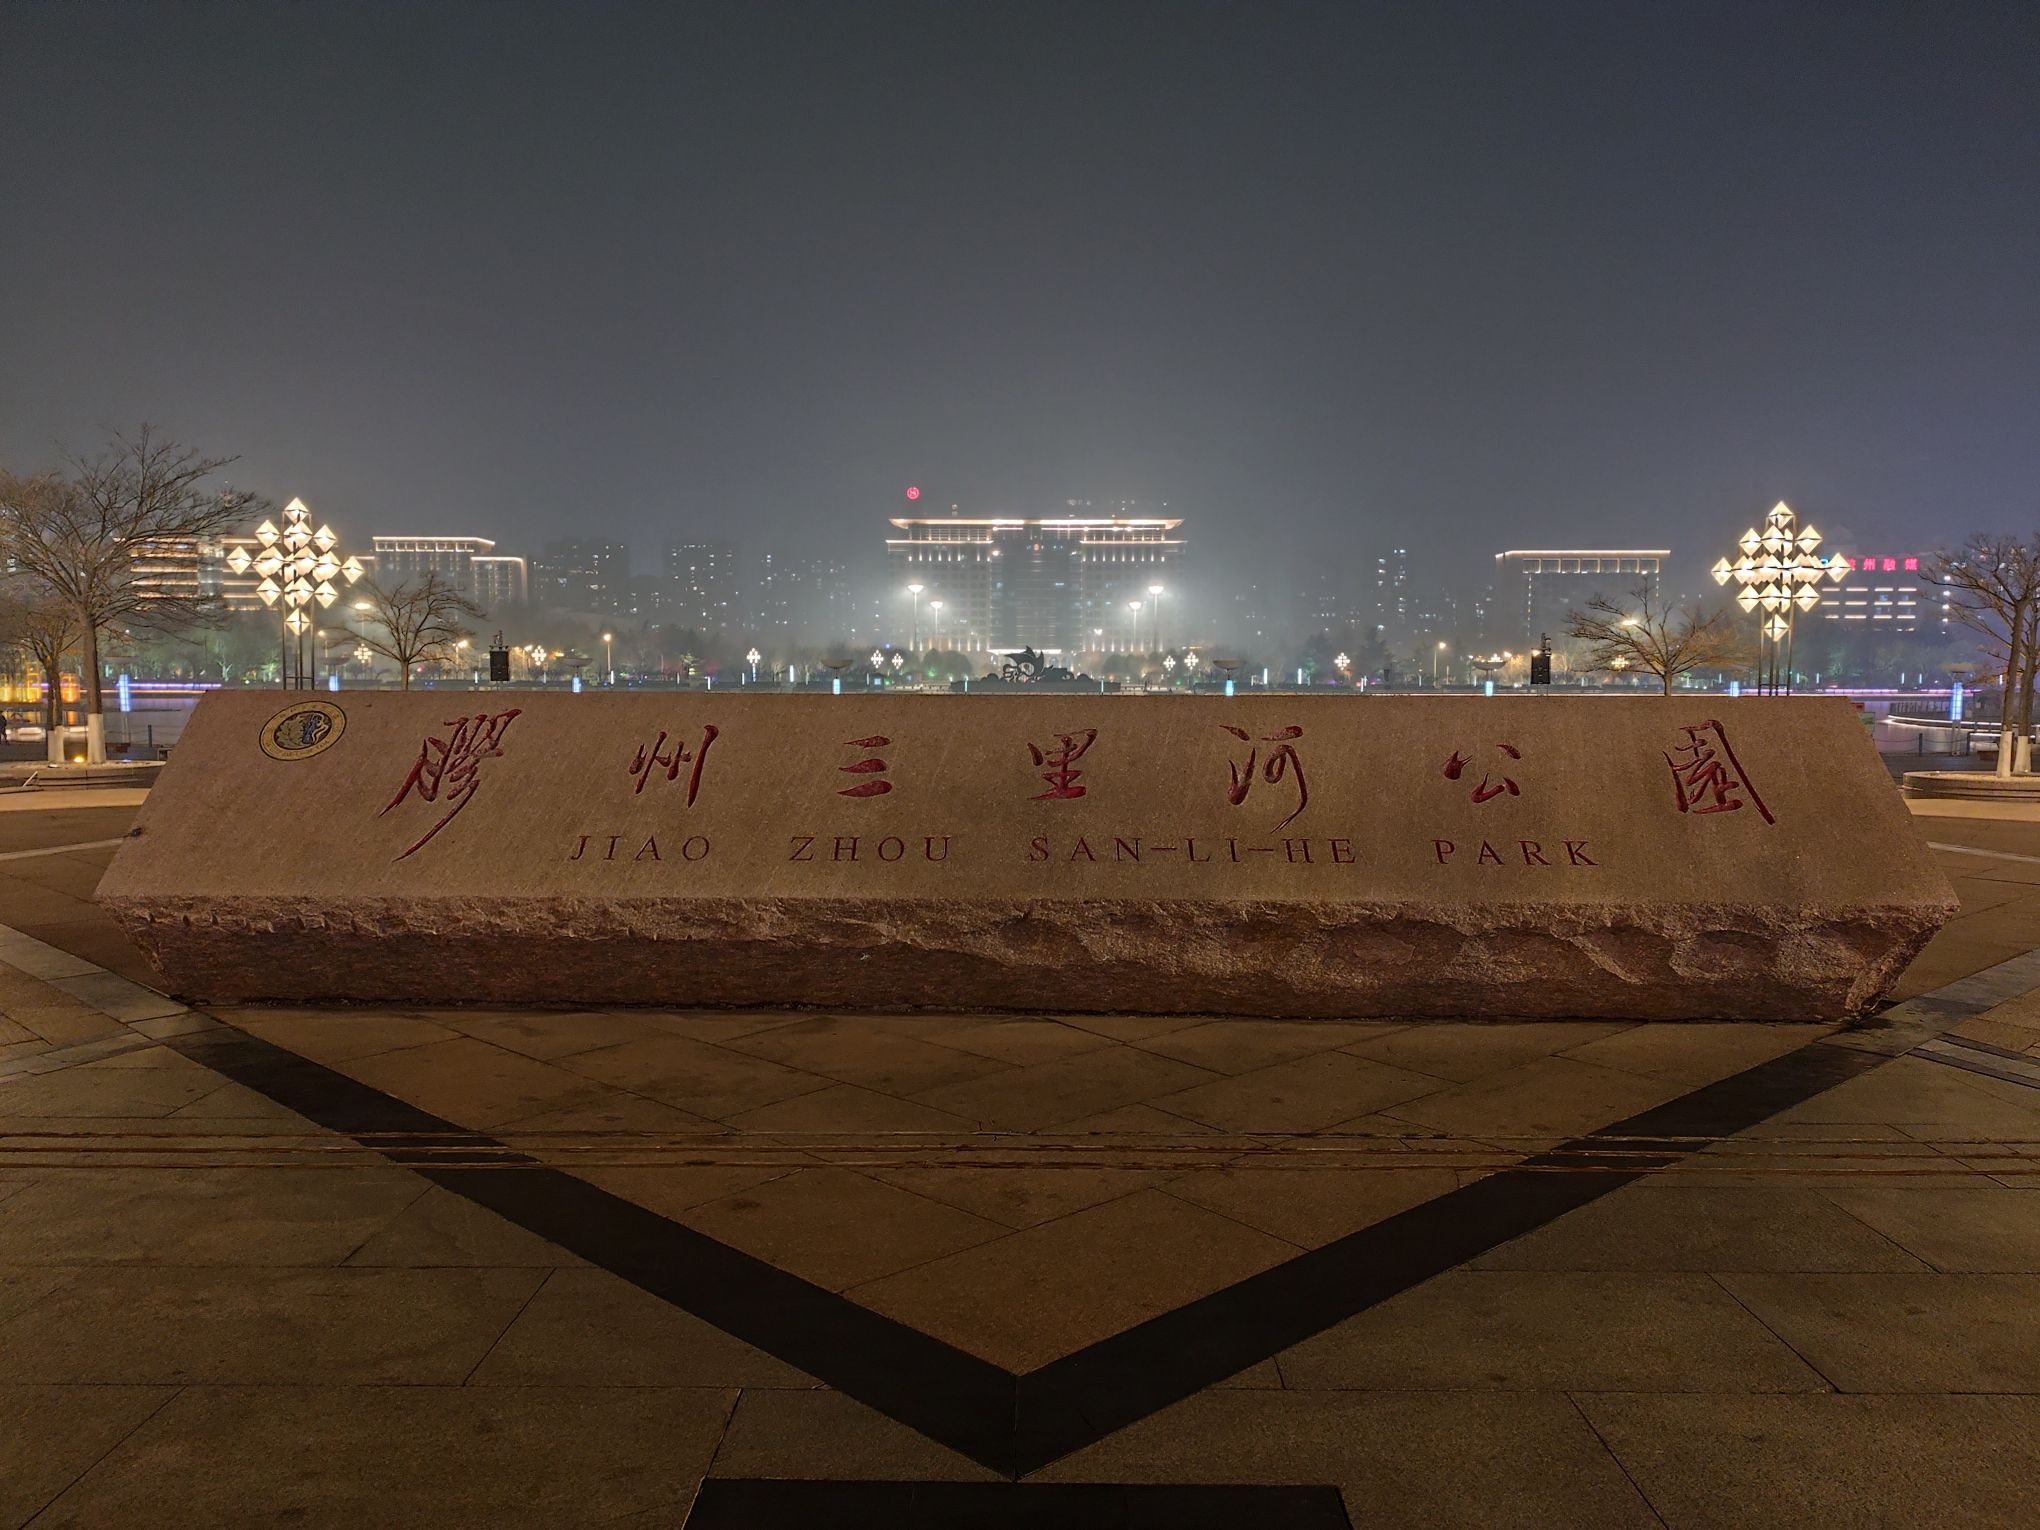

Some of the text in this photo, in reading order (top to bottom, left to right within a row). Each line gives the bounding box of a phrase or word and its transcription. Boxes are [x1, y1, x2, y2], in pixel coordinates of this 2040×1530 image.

[569, 834, 1599, 866] JIAO ZHOU SAN-LI-HE PARK
